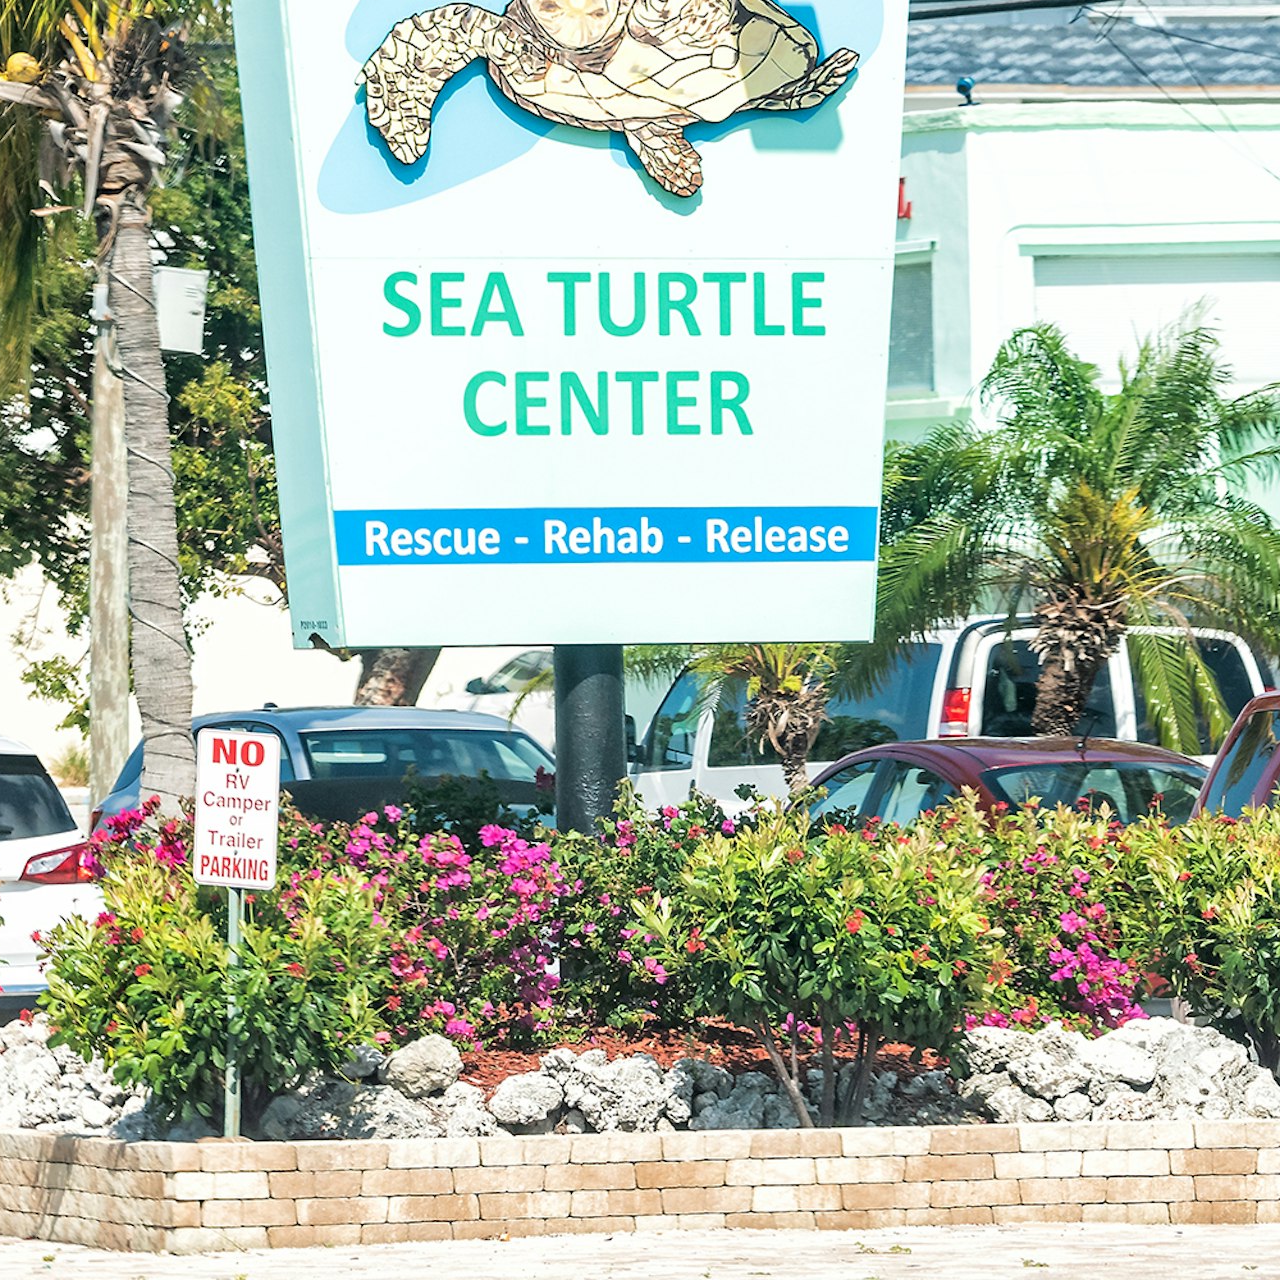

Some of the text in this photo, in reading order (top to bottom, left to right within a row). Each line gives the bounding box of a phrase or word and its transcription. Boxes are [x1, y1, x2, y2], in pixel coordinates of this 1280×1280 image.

[382, 271, 826, 338] SEA TURTLE
[462, 370, 754, 437] CENTER
[365, 520, 500, 556] Rescue
[544, 516, 663, 555] Rehab
[706, 515, 849, 554] Release
[212, 738, 265, 767] NO
[226, 773, 250, 790] RV
[203, 790, 271, 814] Camper
[229, 815, 243, 826] or
[208, 829, 264, 849] Trailer
[200, 854, 269, 881] PARKING
